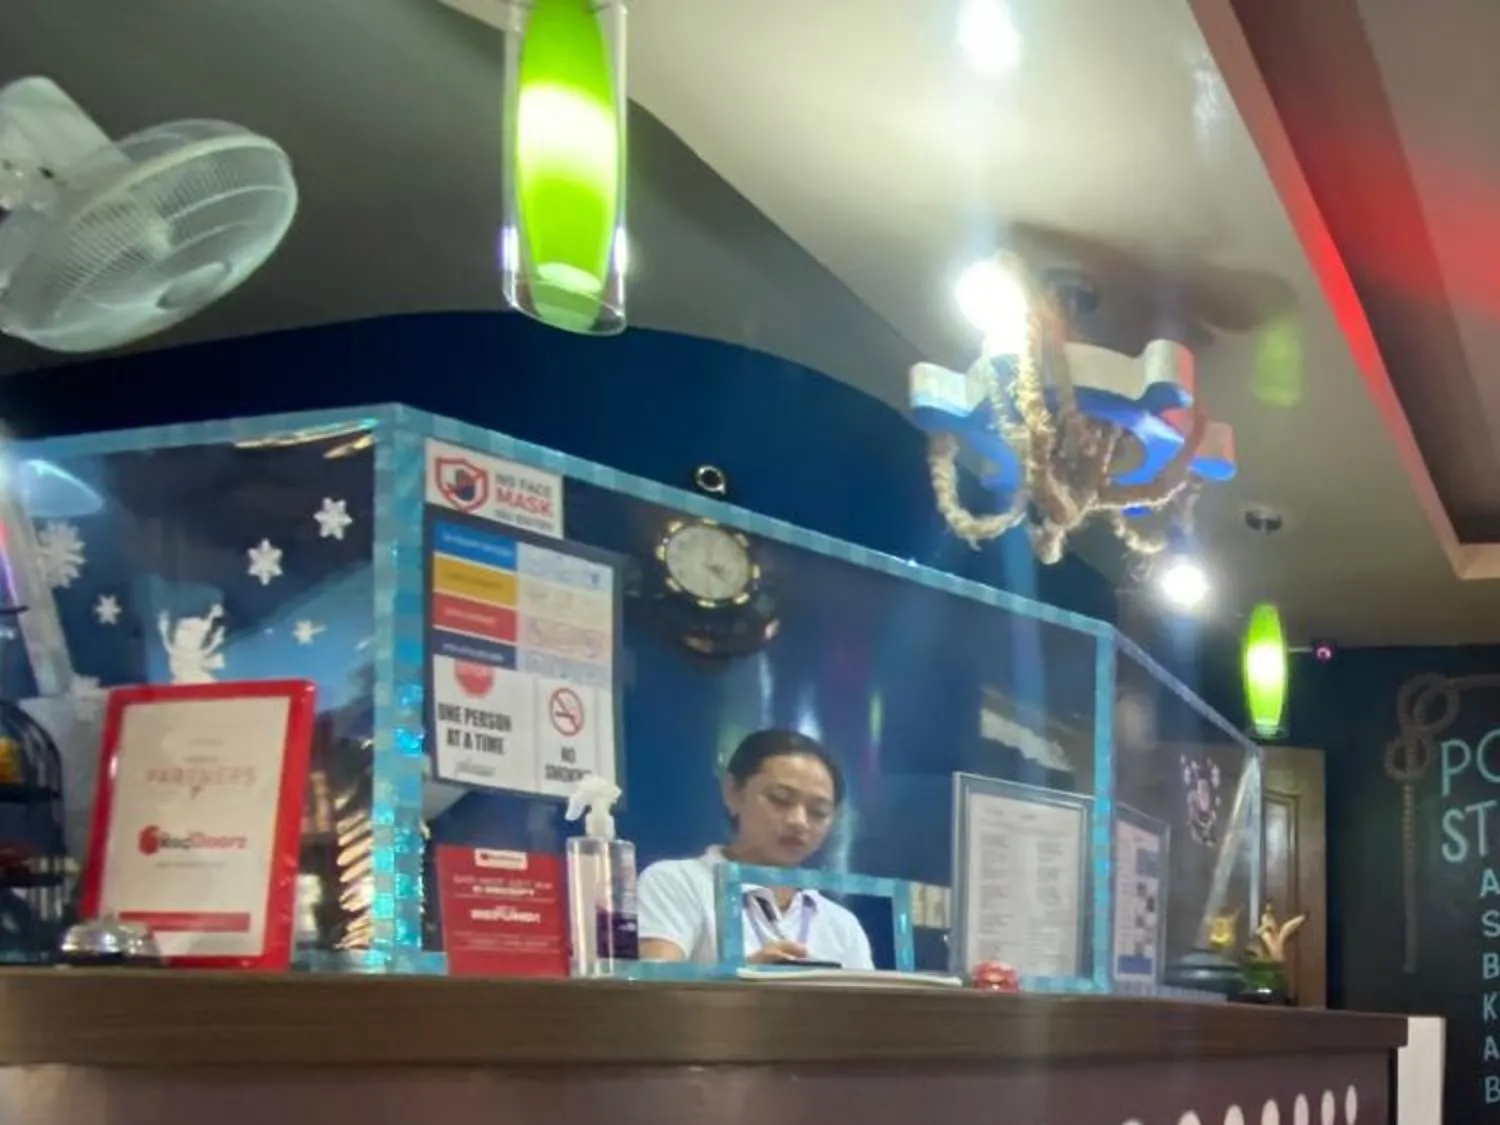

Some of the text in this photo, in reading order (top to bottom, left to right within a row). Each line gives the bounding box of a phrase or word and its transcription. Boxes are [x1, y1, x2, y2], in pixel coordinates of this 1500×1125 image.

[496, 486, 555, 517] MASK
[438, 703, 512, 733] ONE PERSON
[446, 728, 505, 755] AT A TIME
